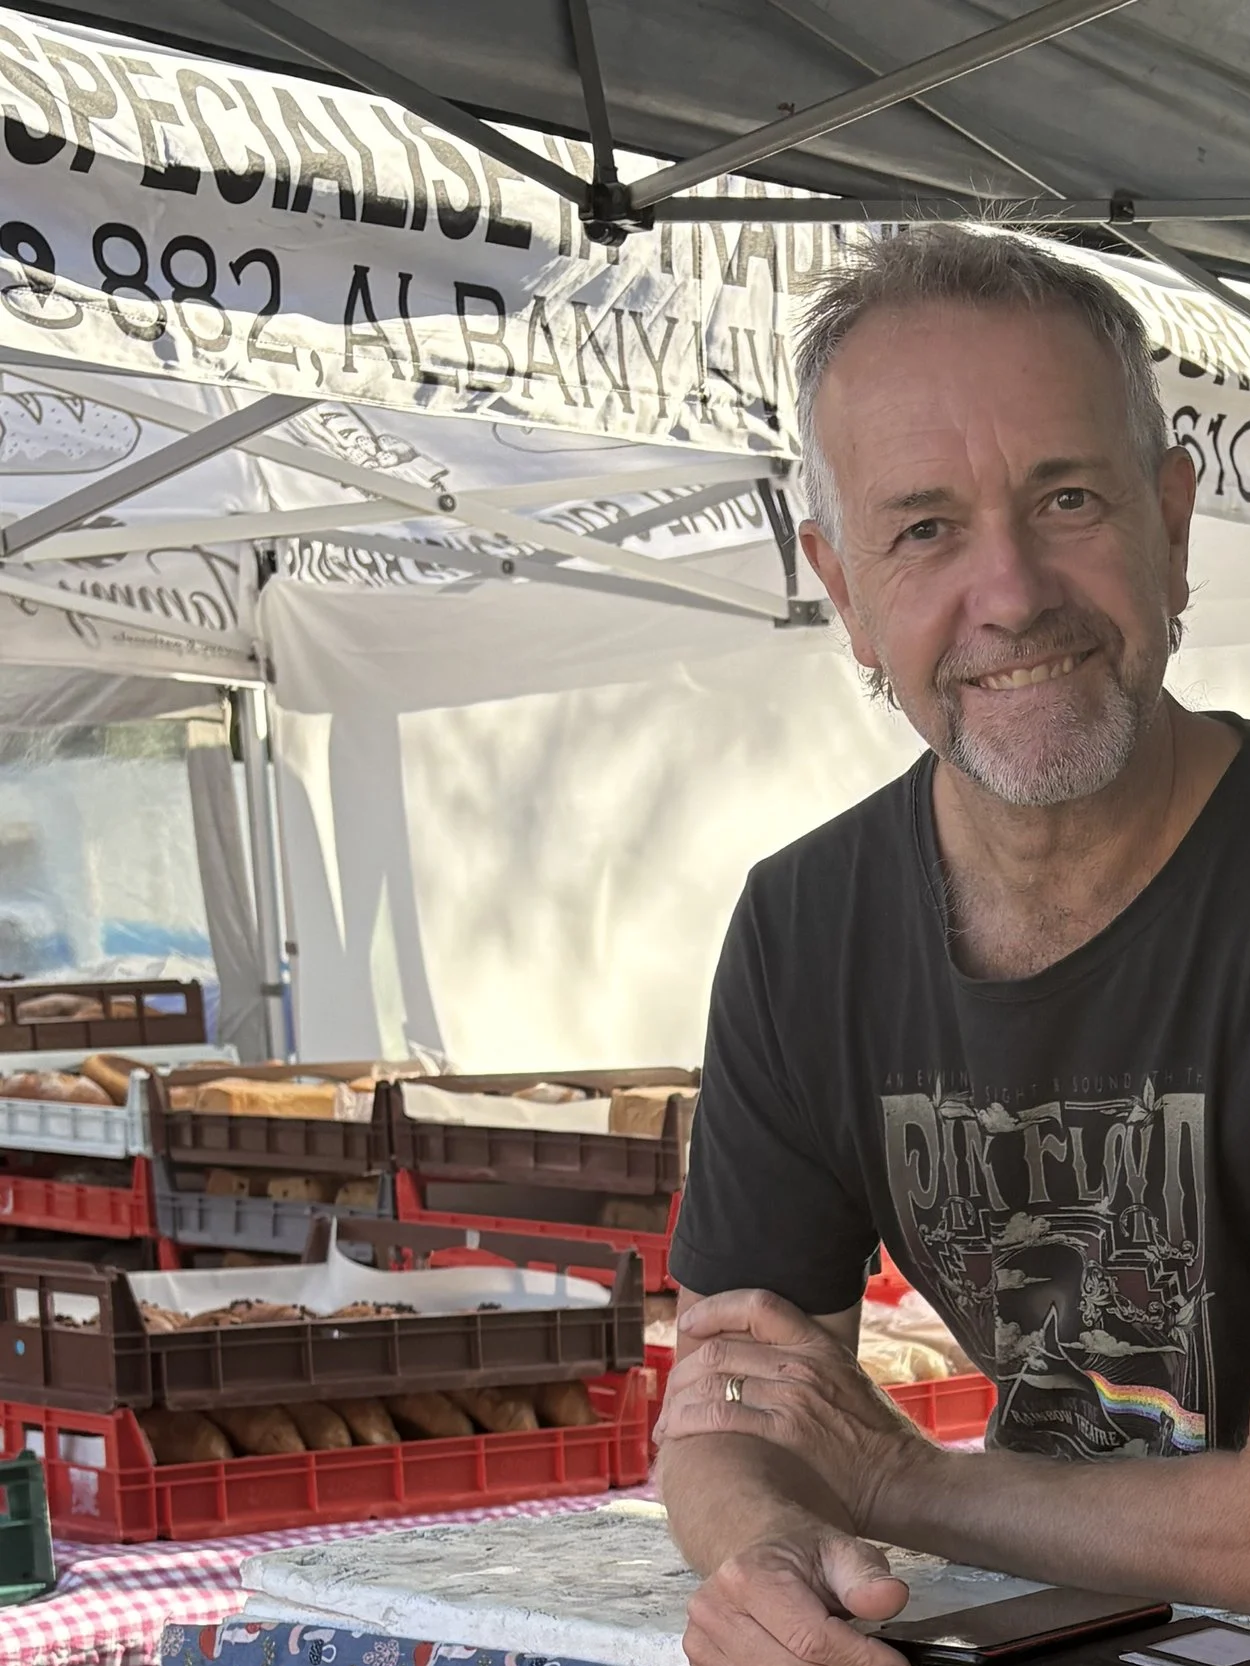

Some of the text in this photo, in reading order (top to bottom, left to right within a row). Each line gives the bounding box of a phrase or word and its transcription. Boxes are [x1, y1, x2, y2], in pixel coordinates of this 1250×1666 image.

[0, 24, 533, 250] SPECIALISE
[92, 221, 325, 388] 882,
[341, 263, 680, 420] ALBANY
